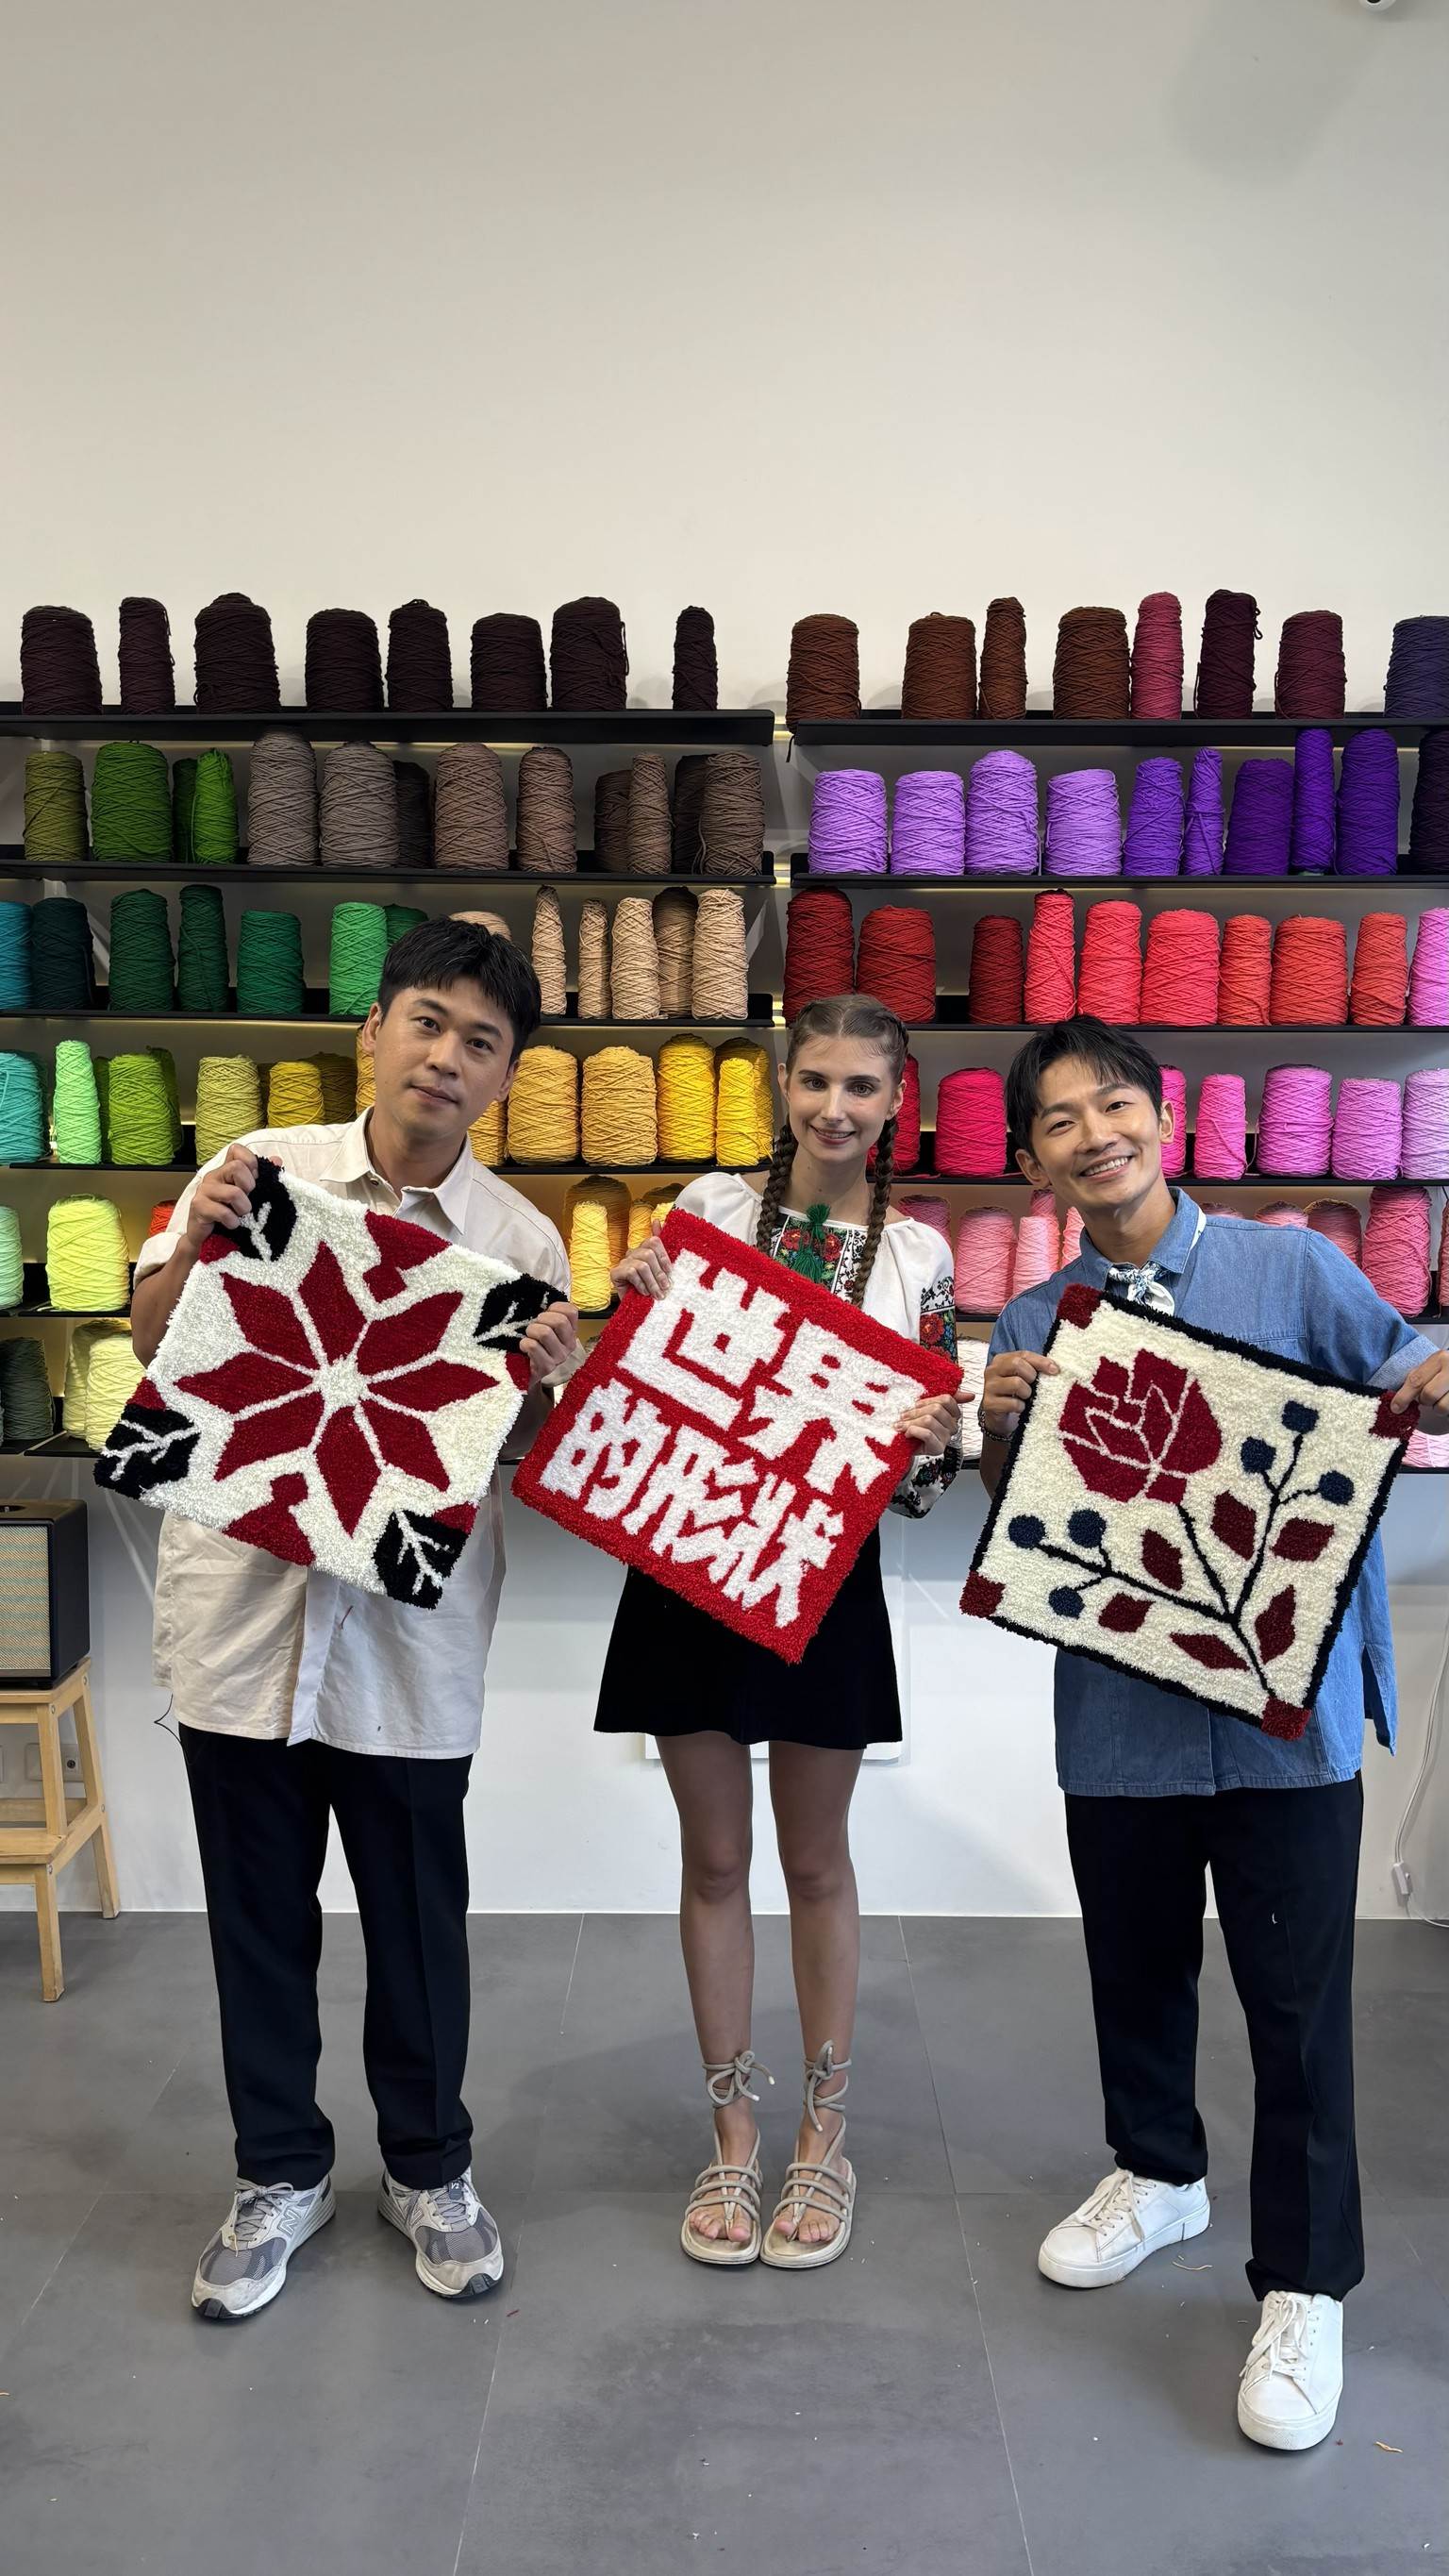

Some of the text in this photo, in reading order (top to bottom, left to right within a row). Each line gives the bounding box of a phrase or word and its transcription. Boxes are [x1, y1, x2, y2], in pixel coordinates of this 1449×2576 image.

[619, 1249, 927, 1495] 世界
[540, 1379, 844, 1628] 的形狀
